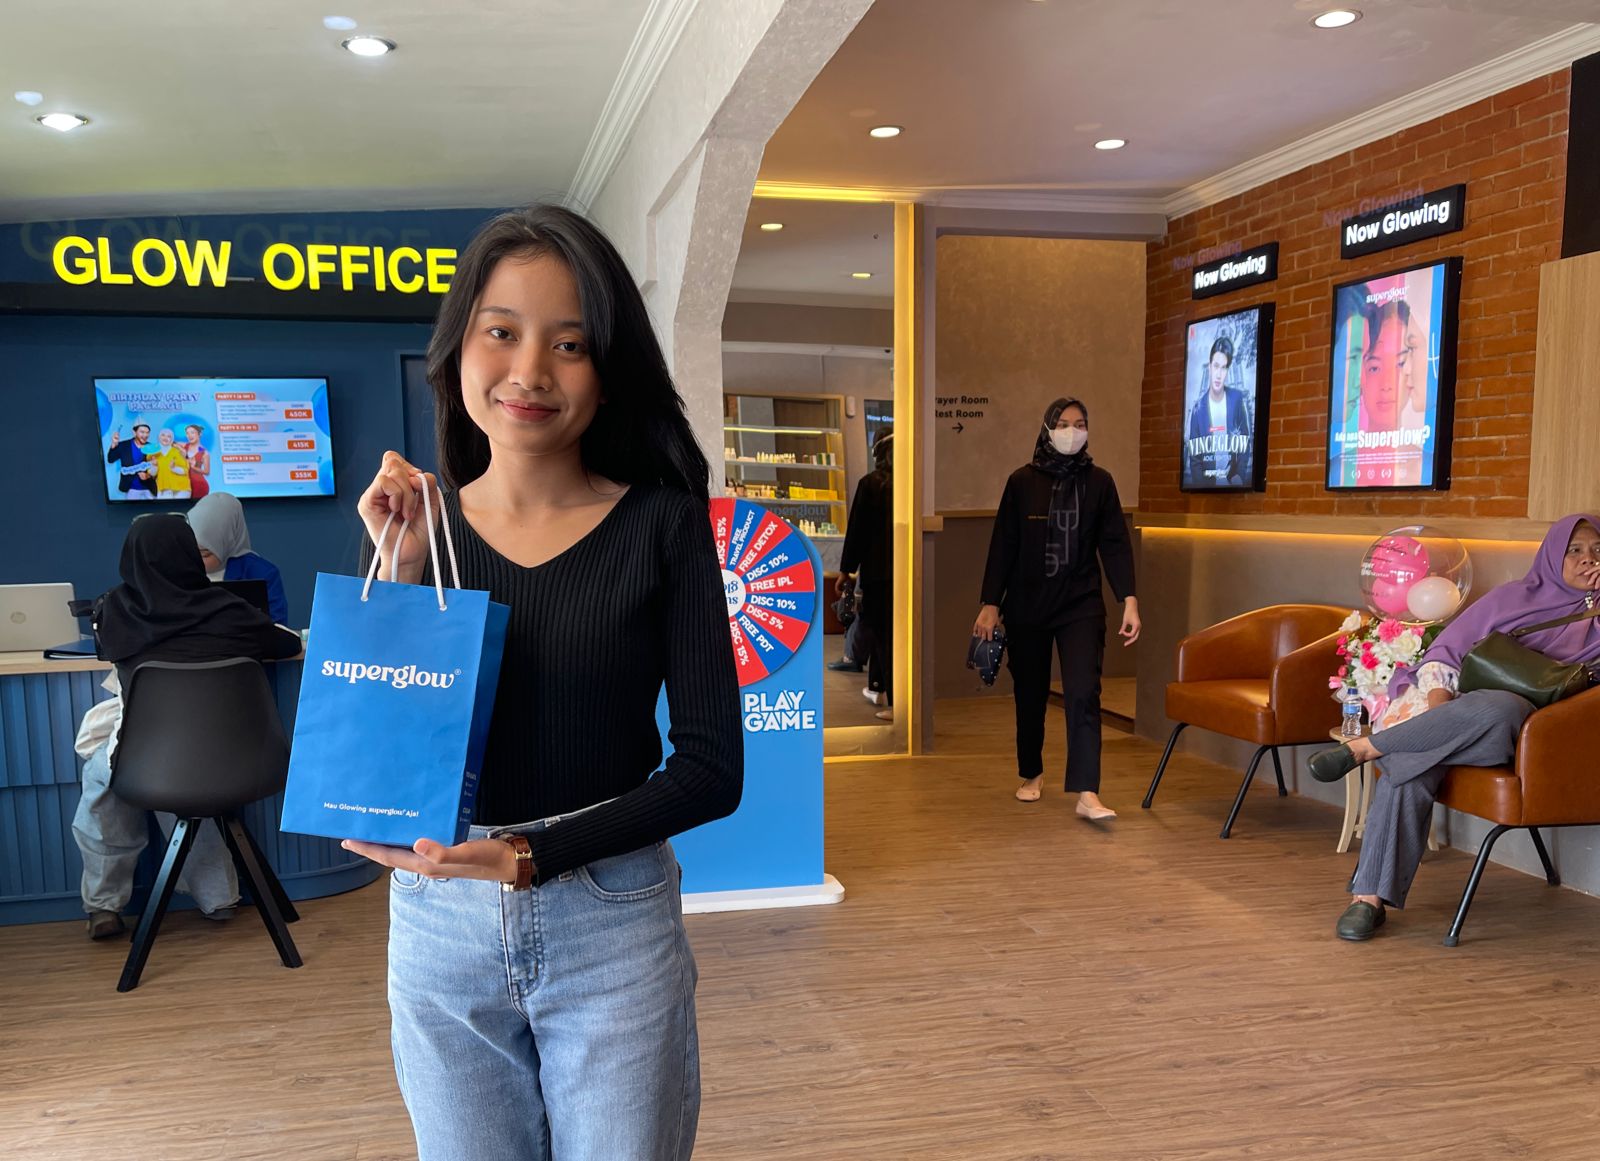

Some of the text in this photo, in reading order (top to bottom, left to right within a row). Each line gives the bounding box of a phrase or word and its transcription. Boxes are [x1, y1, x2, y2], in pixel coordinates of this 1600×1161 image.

[1346, 201, 1450, 246] Now Glowing
[52, 235, 457, 294] GLOW OFFICE
[1194, 255, 1267, 289] Now Glowing
[935, 395, 989, 406] ayer Room
[956, 409, 984, 418] Room
[1188, 433, 1250, 456] VINCEGLOW
[1358, 425, 1431, 449] Superglow?
[716, 516, 727, 565] DISC 15%
[729, 509, 755, 566] TRAVEL PRODUCT
[731, 527, 743, 545] FREE
[738, 520, 778, 573] FREE DETOX
[746, 552, 789, 582] DISC 10%
[750, 575, 793, 592] FREE IPL
[750, 594, 774, 607] DISC
[776, 598, 797, 611] 10%
[746, 604, 784, 630] DISC 5%
[729, 621, 743, 645] DISC
[736, 645, 750, 666] 15%
[738, 615, 775, 653] FREE PDT
[744, 690, 806, 713] PLAY
[744, 710, 816, 733] GAME
[339, 803, 367, 814] Glowing
[405, 810, 420, 818] Aja!
